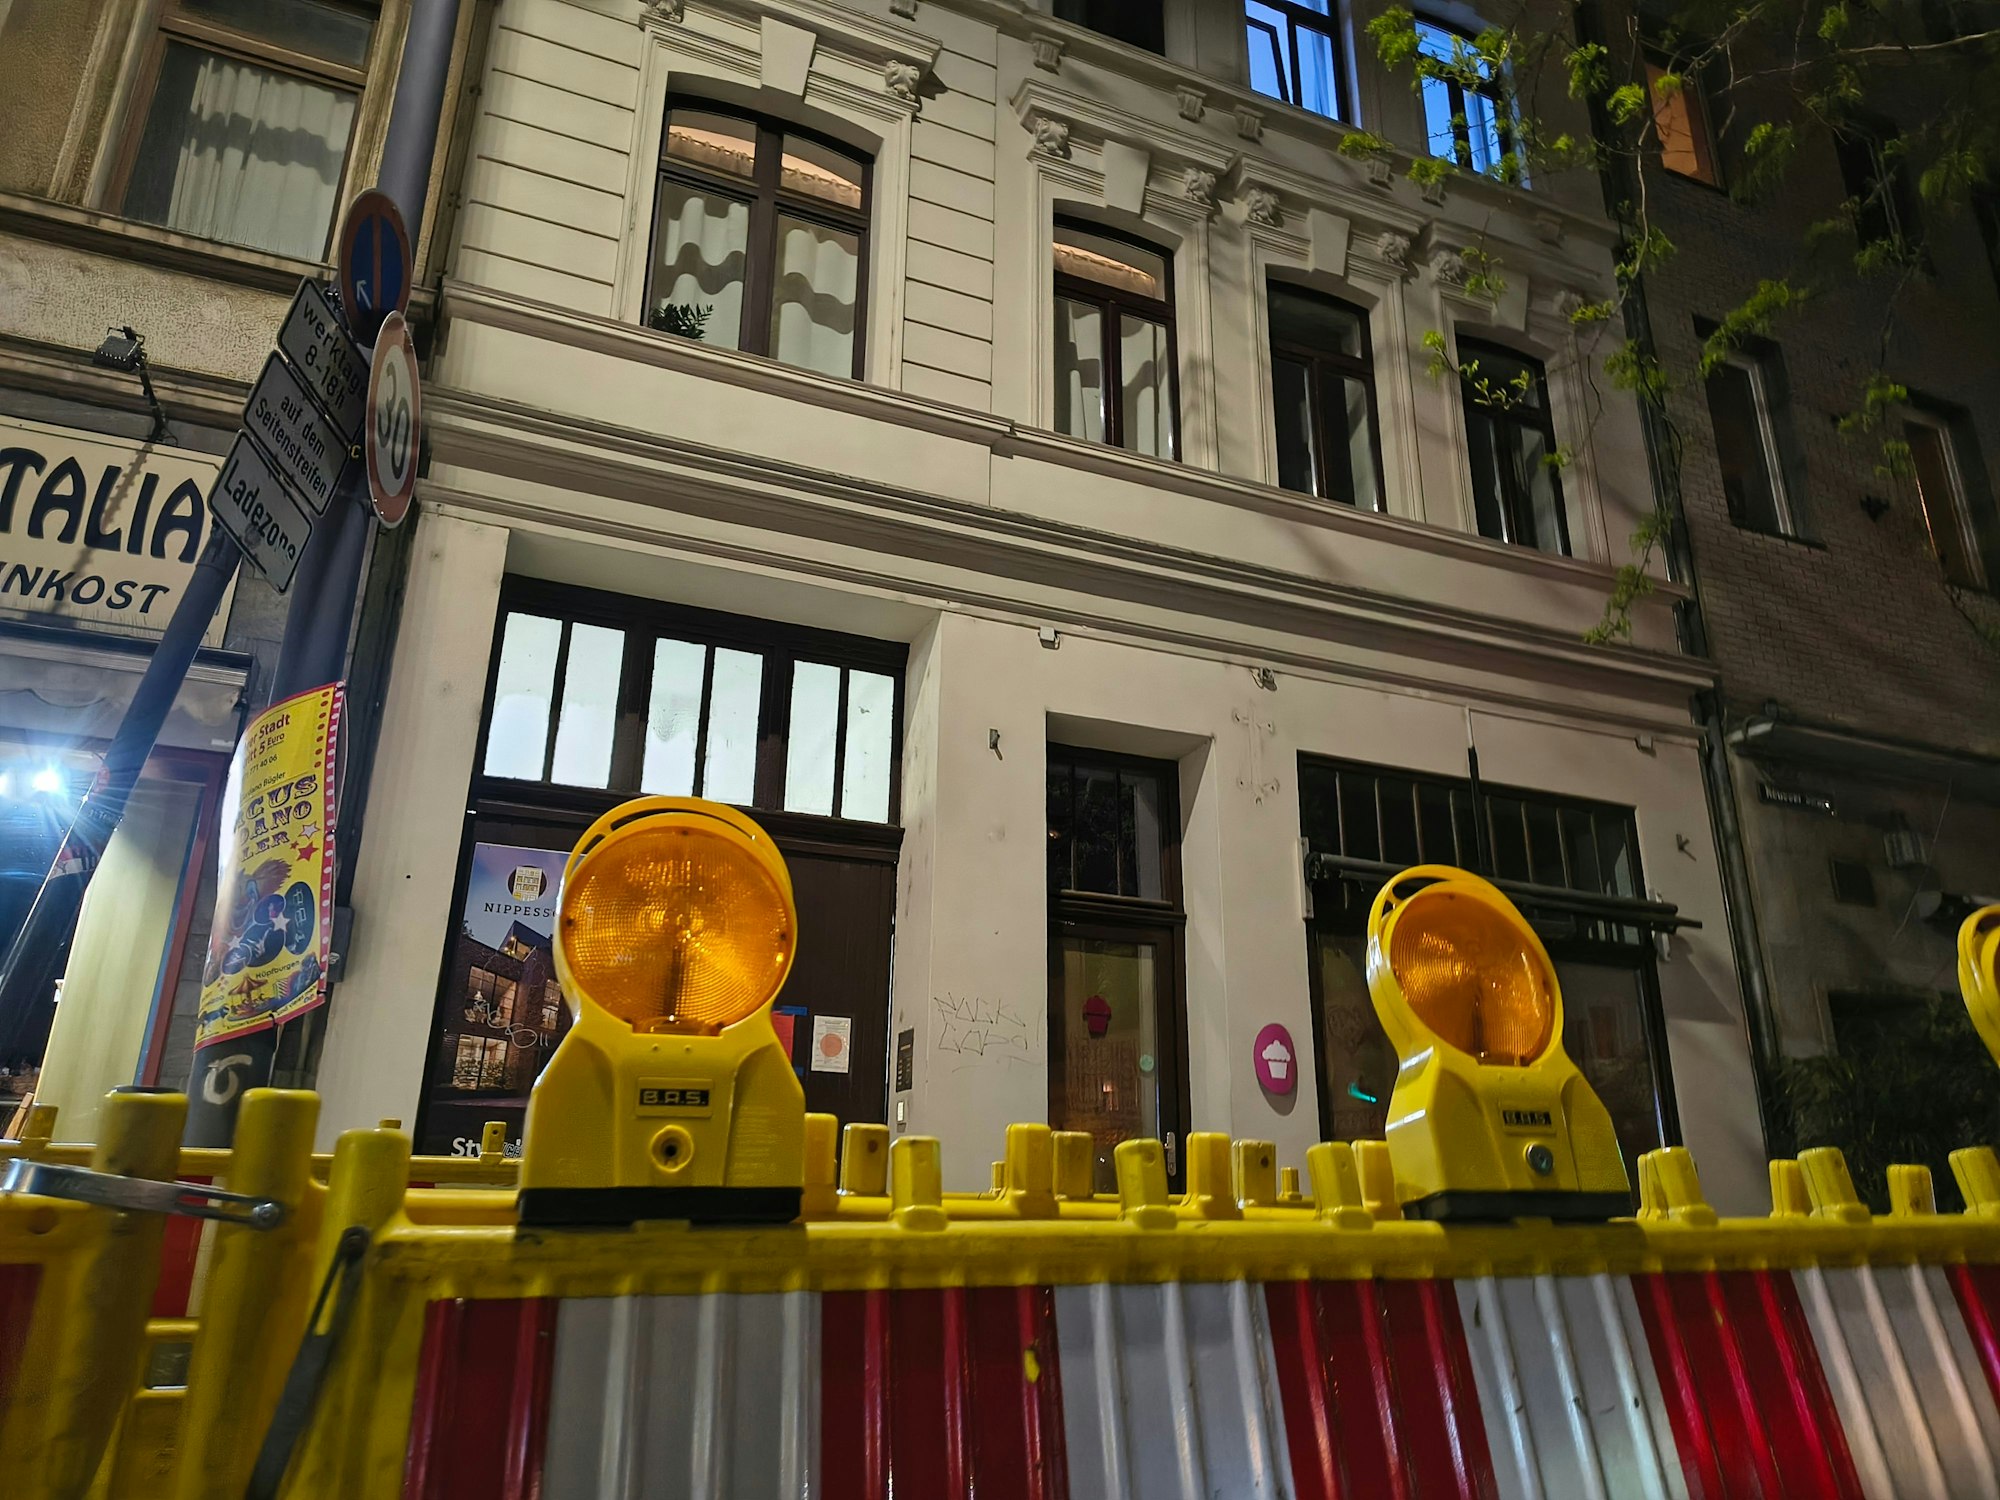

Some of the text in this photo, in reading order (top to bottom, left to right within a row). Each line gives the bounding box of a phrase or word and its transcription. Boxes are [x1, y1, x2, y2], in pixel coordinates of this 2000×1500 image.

[280, 396, 325, 460] auf dem
[377, 361, 410, 480] 30
[255, 397, 328, 500] Seitenstreifen
[259, 713, 291, 739] Stadt
[267, 732, 285, 747] Euro
[484, 902, 557, 918] NIPPESS
